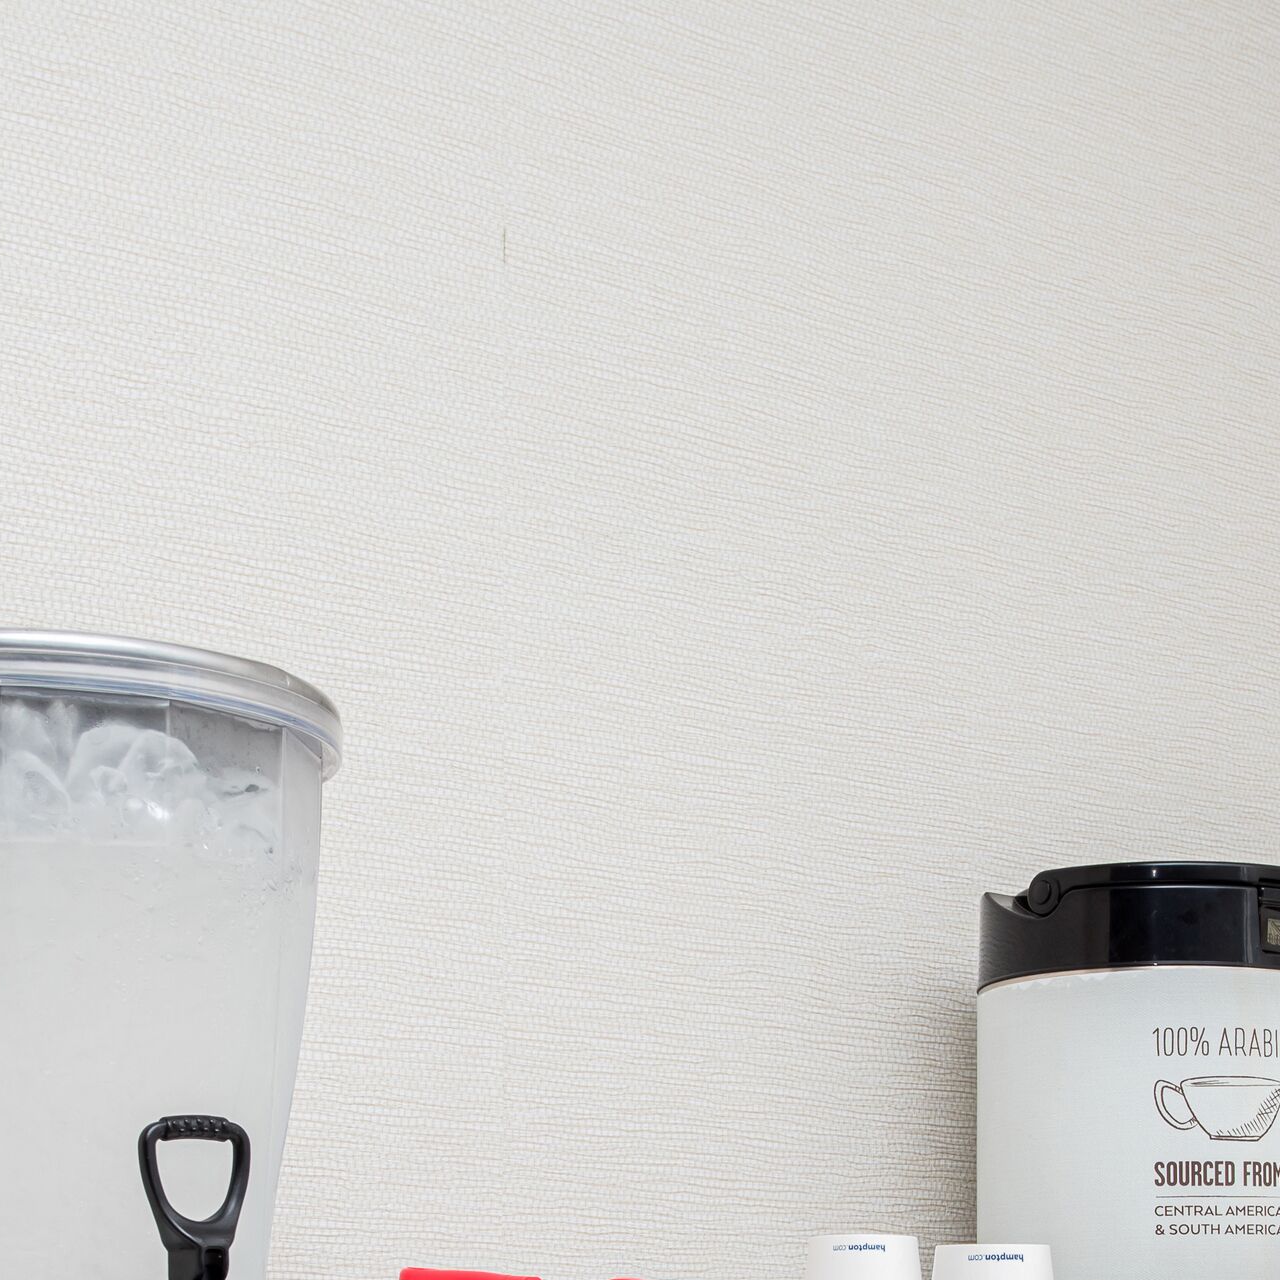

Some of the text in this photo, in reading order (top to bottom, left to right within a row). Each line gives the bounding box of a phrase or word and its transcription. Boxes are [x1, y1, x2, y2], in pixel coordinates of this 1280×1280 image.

[1152, 1026, 1210, 1057] 100%
[1154, 1160, 1235, 1187] SOURCED
[1154, 1205, 1223, 1217] CENTRAL
[1155, 1223, 1165, 1236] &
[1169, 1223, 1221, 1236] SOUTH
[832, 1242, 886, 1253] hampton.com
[967, 1252, 1024, 1263] hampton.com
